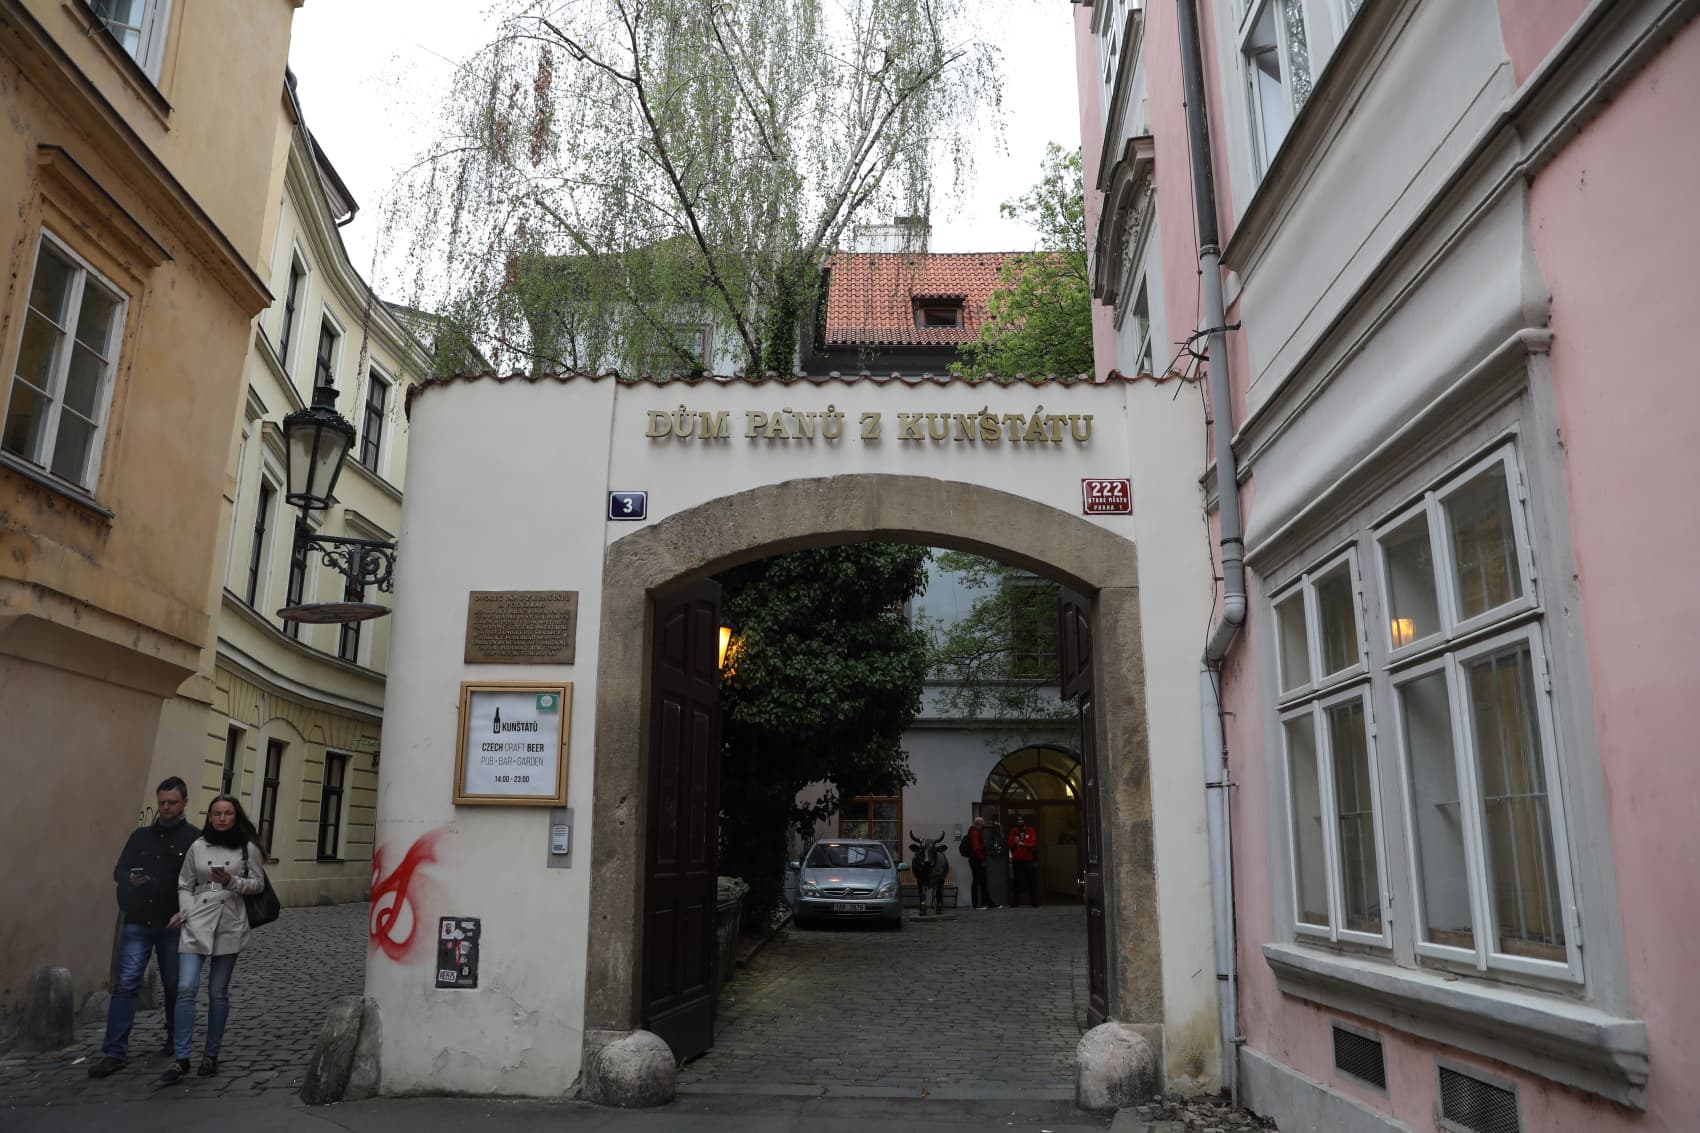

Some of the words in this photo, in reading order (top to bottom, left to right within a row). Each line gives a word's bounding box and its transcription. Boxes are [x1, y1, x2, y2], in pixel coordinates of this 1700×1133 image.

[645, 404, 730, 440] DŮM
[744, 404, 845, 440] PÁNŮ
[858, 412, 882, 440] Z
[1092, 482, 1122, 497] 222
[623, 498, 633, 513] 3
[482, 743, 503, 752] CZECH
[505, 743, 525, 752] CRAFT
[527, 744, 544, 752] BEER
[480, 756, 494, 765] PUB
[498, 757, 513, 766] BAR
[516, 757, 544, 766] GARDEN
[495, 775, 510, 783] 14:00
[513, 775, 529, 783] 23:00
